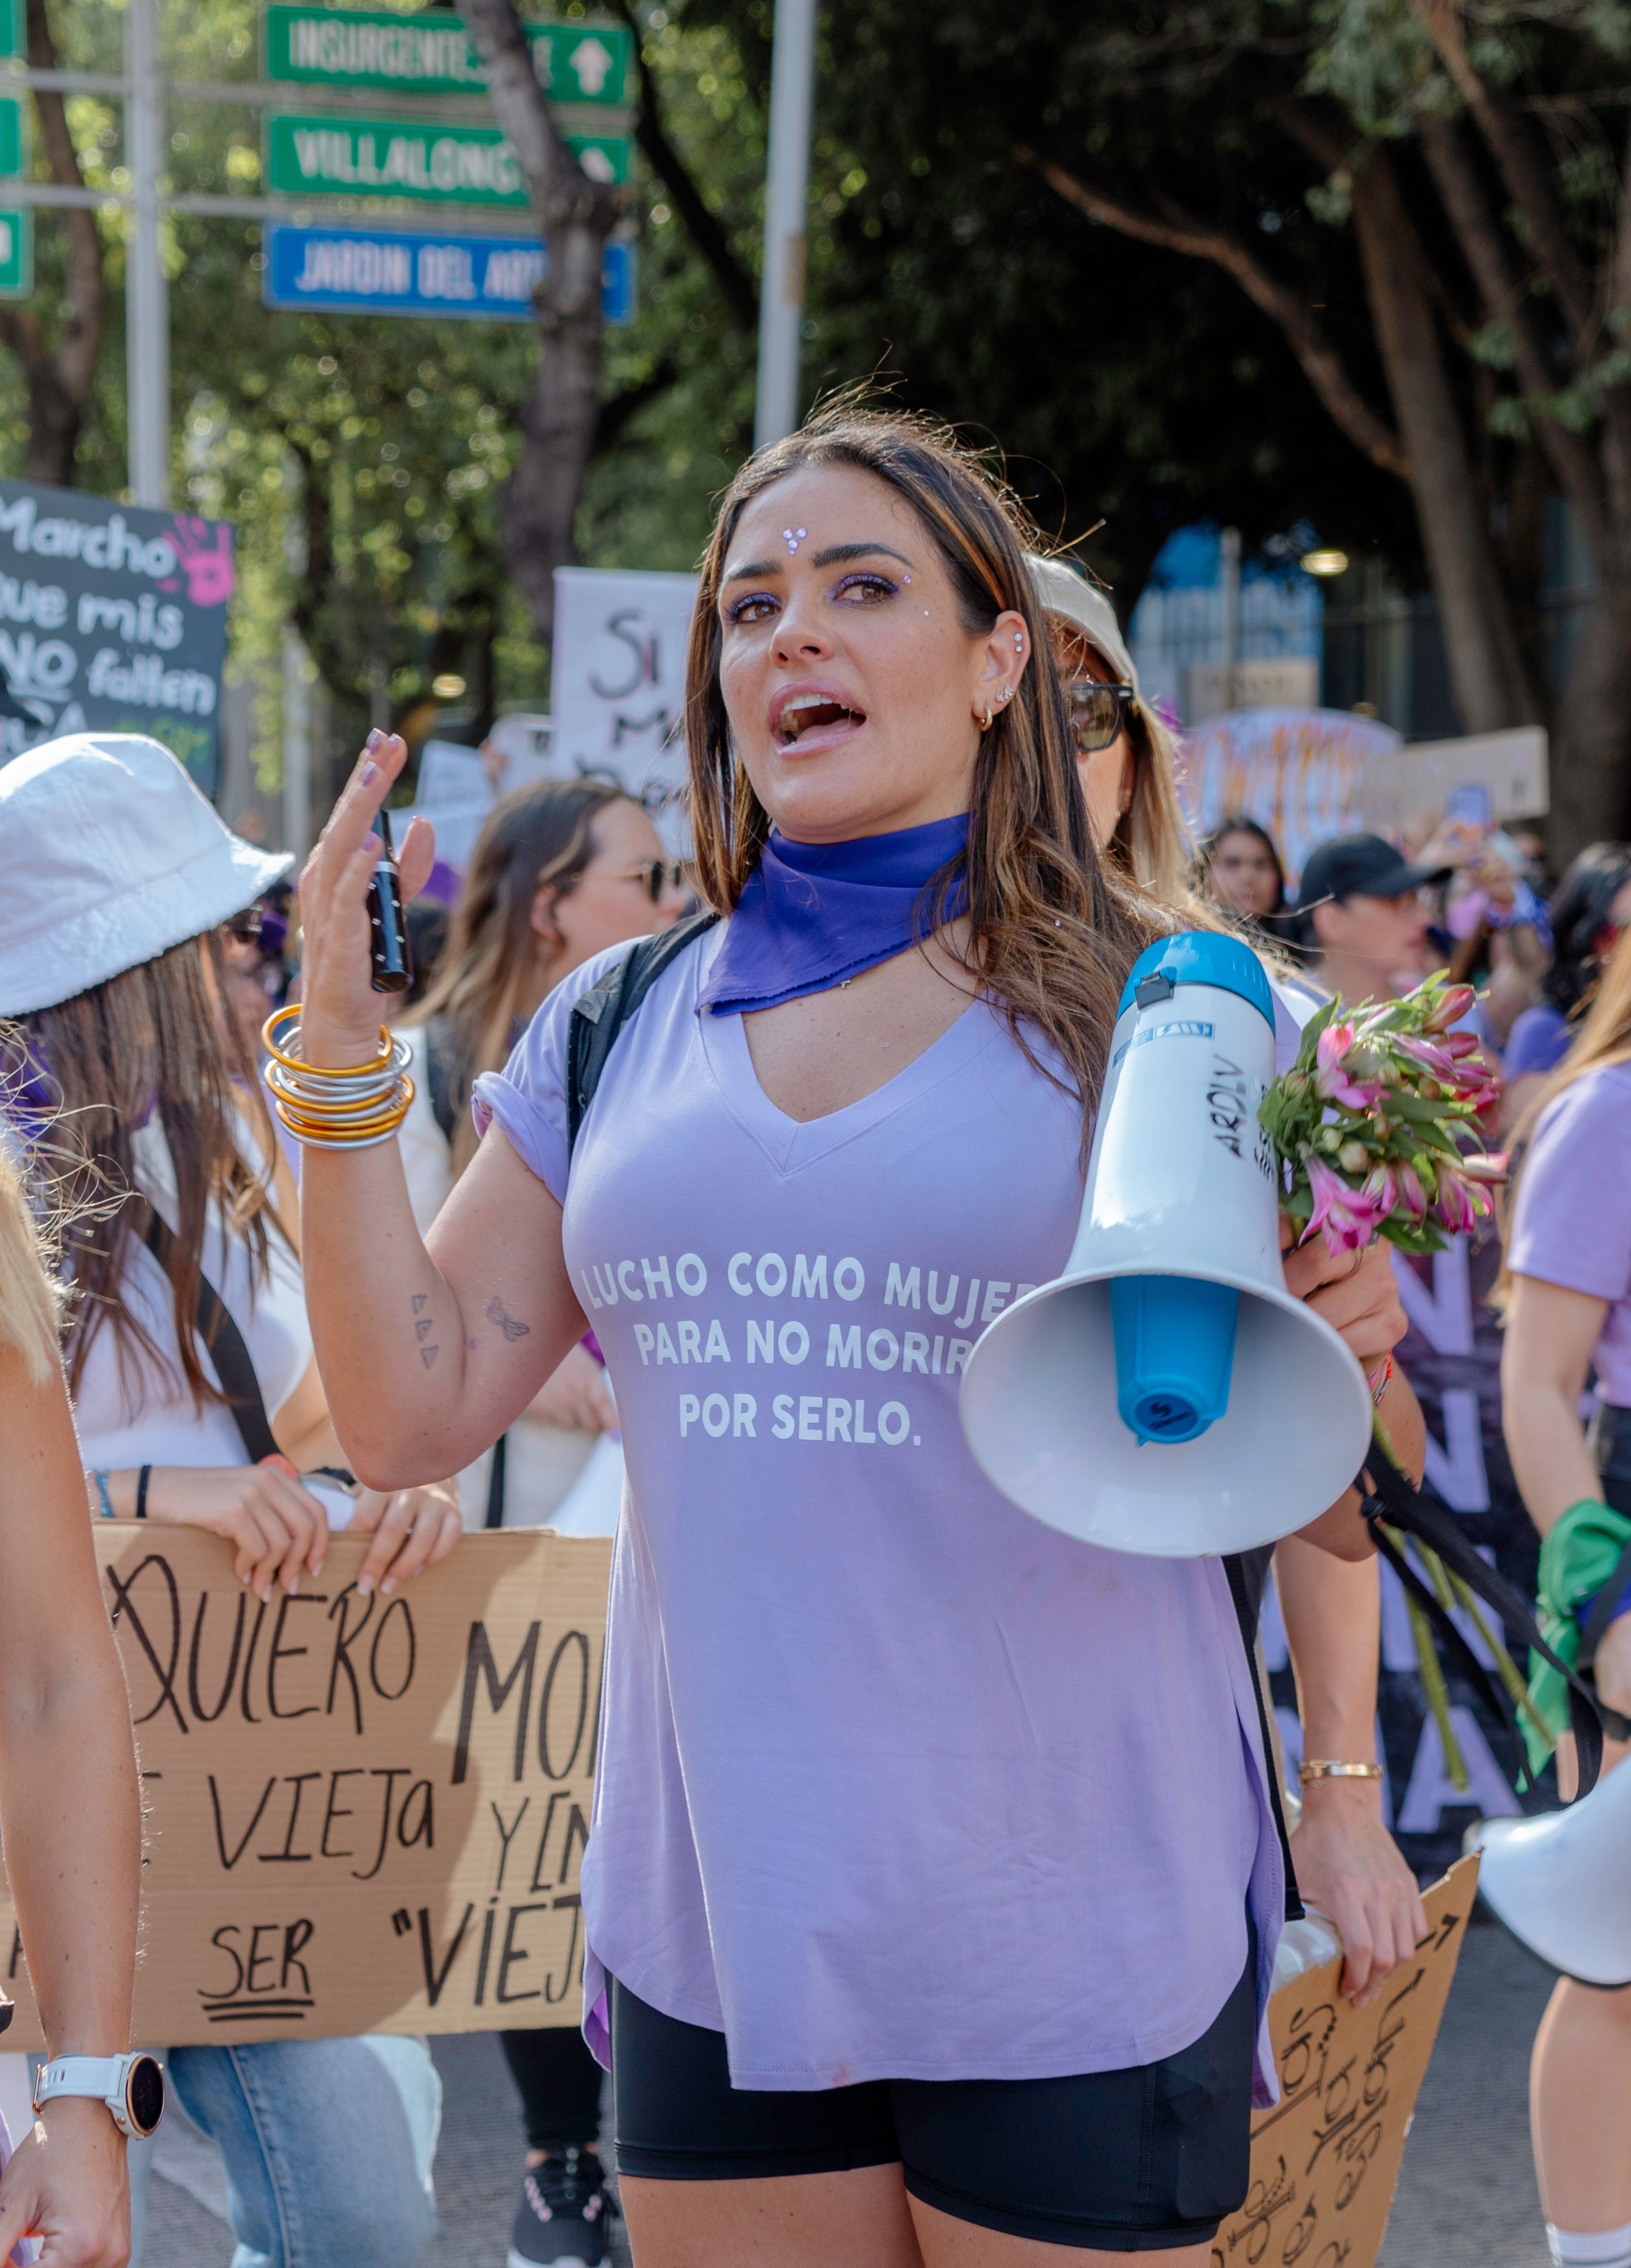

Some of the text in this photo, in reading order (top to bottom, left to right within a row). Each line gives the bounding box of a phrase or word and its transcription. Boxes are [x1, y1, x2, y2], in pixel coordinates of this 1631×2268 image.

[293, 128, 523, 195] VILLALONG
[294, 239, 412, 295] JARDIN
[417, 244, 477, 301] DEL
[0, 495, 177, 578] Marcho
[0, 574, 184, 650] ue mis
[581, 1253, 707, 1309] LUCHO
[728, 1252, 865, 1301] COMO
[634, 1319, 973, 1375] PARA NO MORIR
[679, 1393, 921, 1446] POR SERLO.
[108, 1555, 606, 1786] QUIERO MO
[197, 1918, 314, 1998] SER
